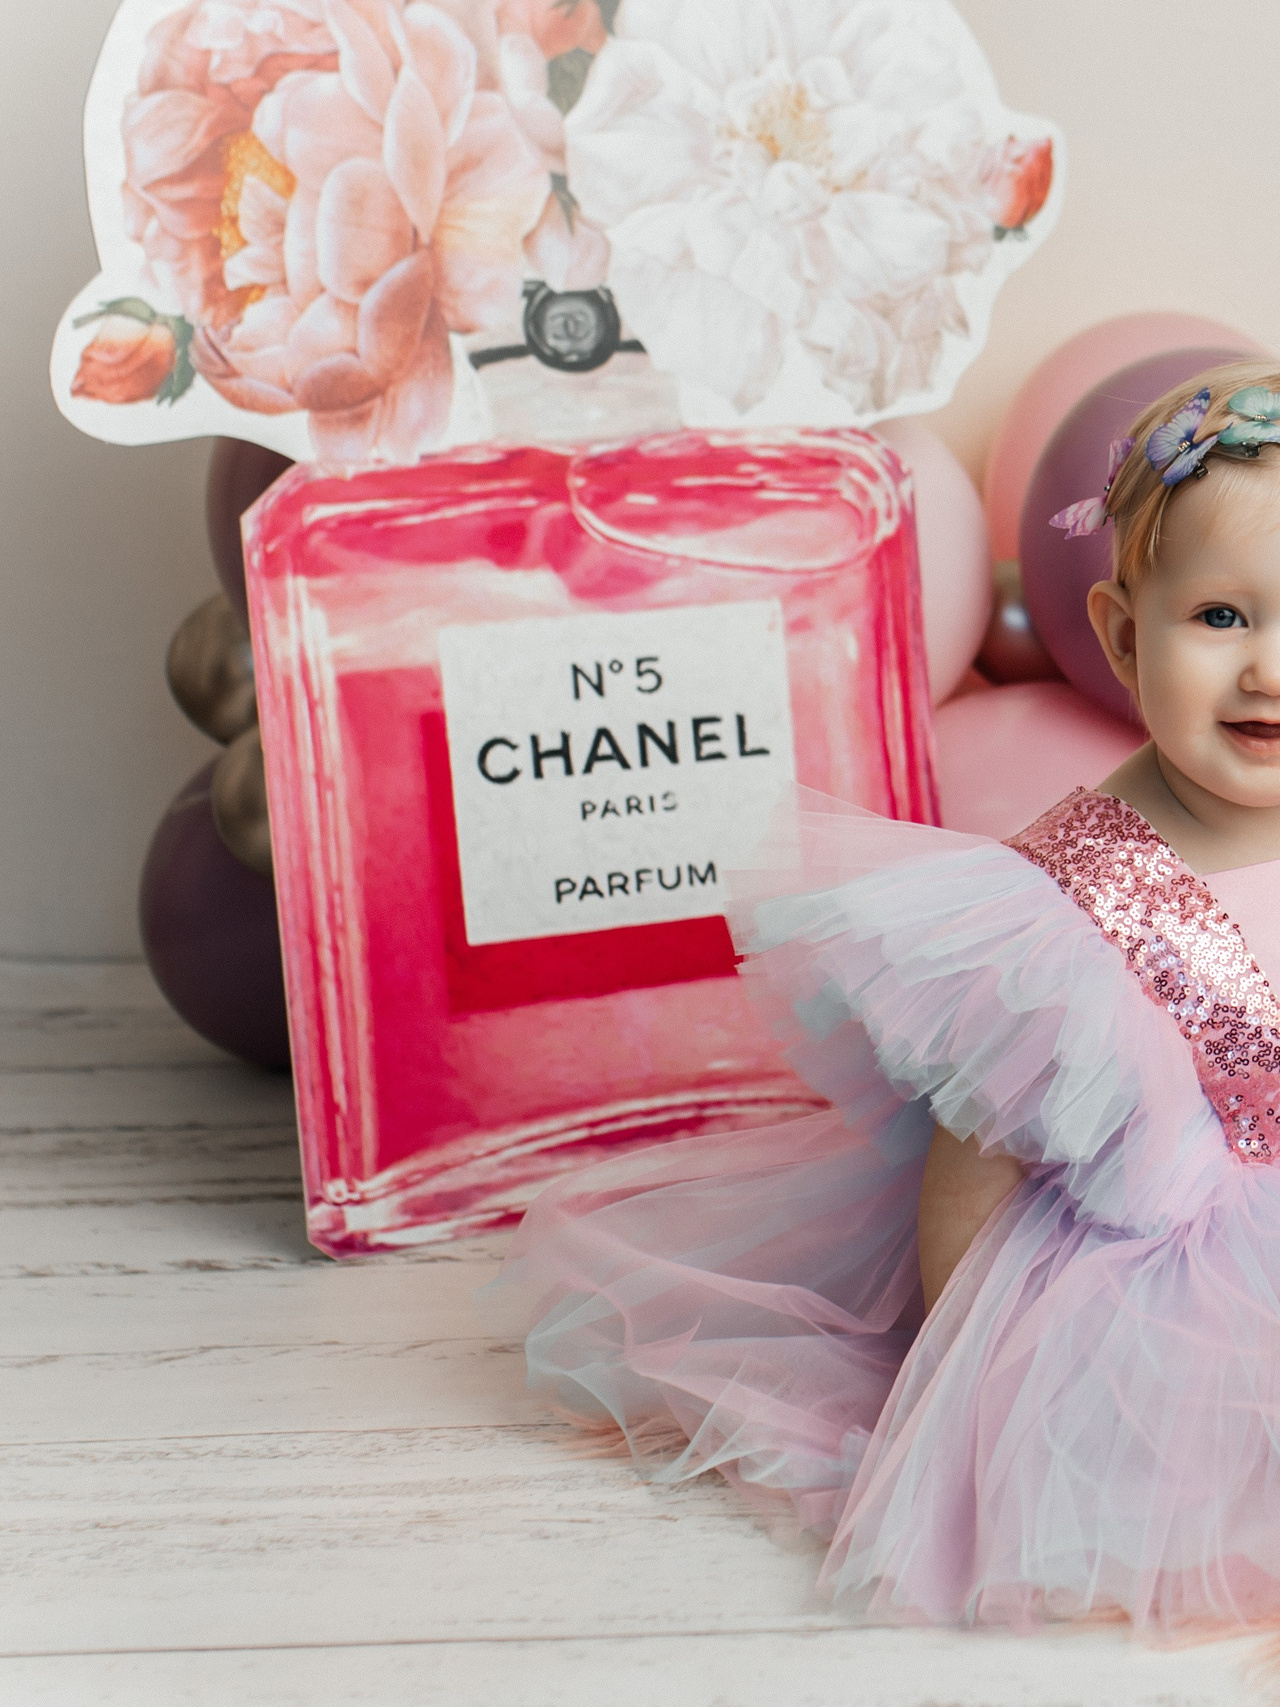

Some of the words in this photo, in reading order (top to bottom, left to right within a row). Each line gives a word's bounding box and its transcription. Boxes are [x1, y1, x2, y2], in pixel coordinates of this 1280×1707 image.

[477, 713, 770, 785] CHANEL
[581, 791, 678, 821] PARIS
[554, 861, 718, 904] PARFUM
